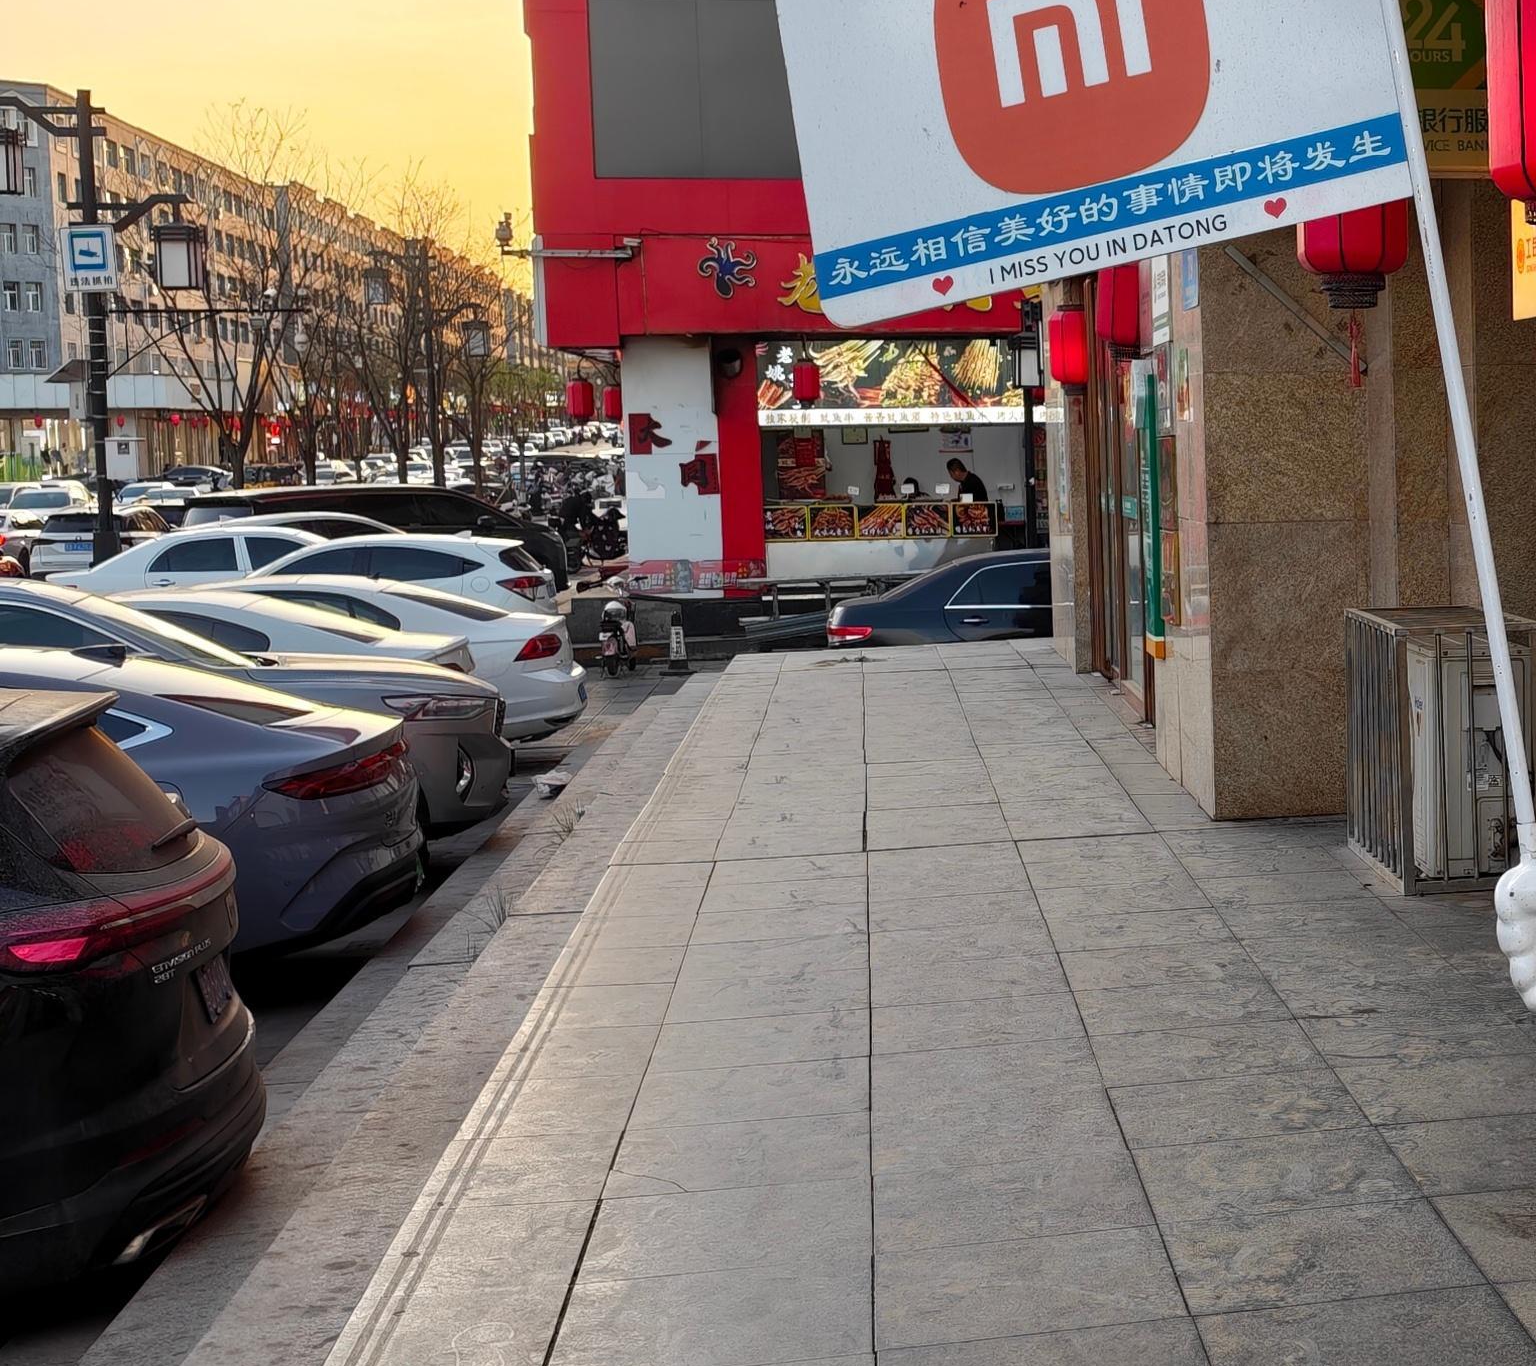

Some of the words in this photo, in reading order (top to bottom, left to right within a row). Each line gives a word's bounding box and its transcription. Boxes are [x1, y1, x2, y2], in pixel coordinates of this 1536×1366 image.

[828, 130, 1392, 286] 永远相信美好的事情即将发生
[989, 268, 995, 285] I
[1001, 255, 1048, 282] MISS
[1053, 244, 1100, 268] YOU
[1107, 238, 1127, 258] IN
[1133, 214, 1228, 251] DATONG
